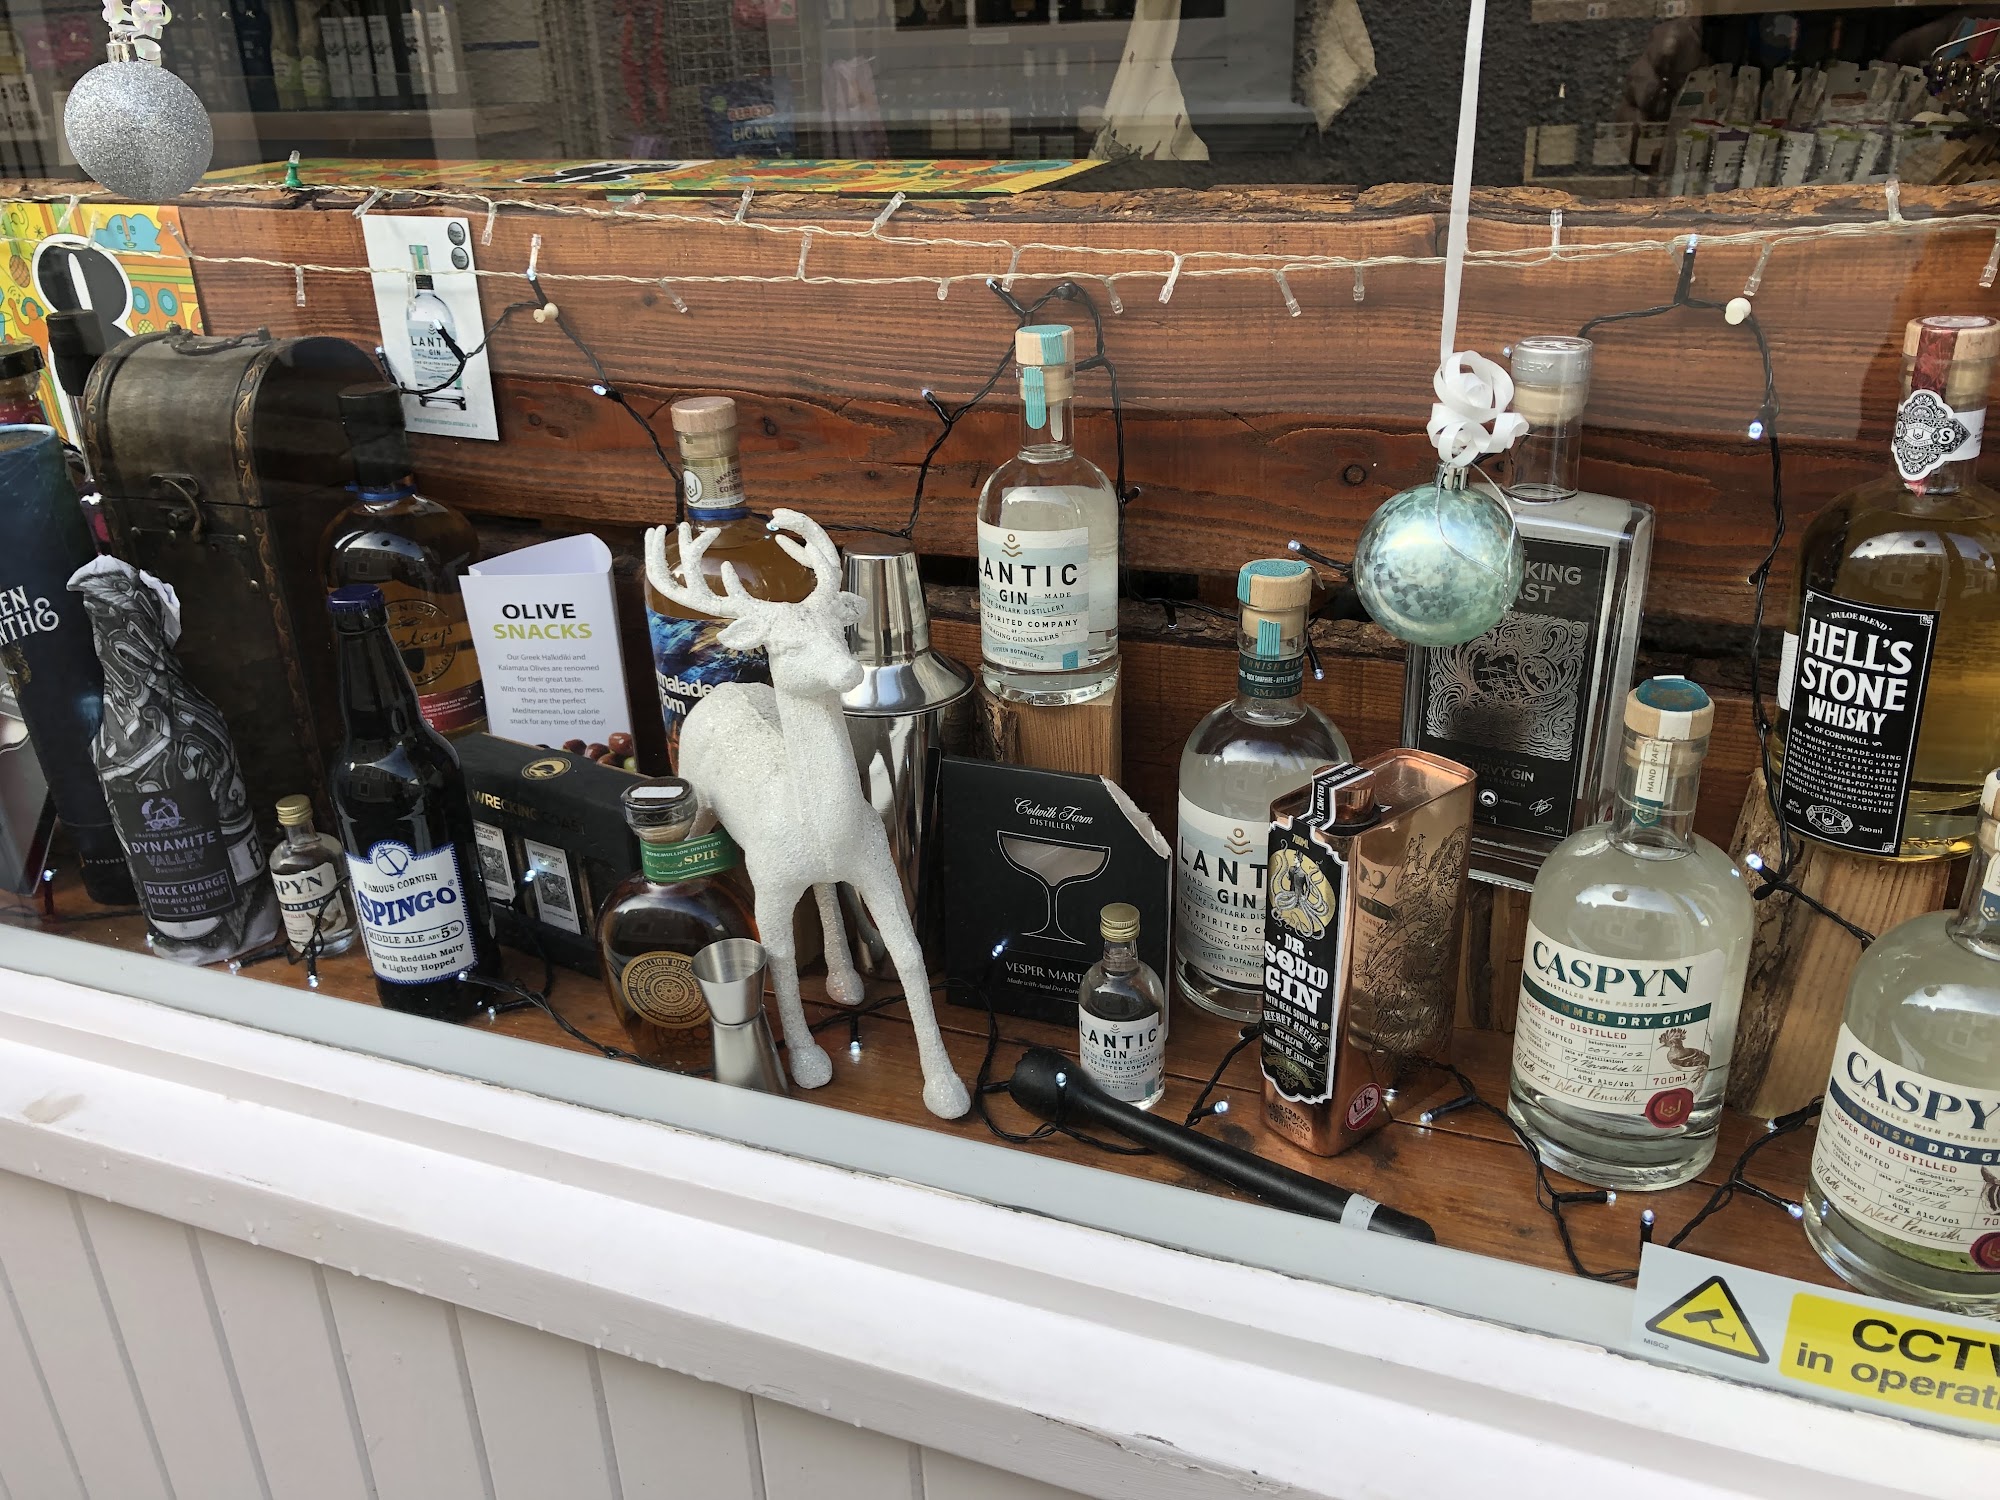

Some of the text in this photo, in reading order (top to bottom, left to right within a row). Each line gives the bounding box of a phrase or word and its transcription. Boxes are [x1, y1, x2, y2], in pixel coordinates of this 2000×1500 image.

[995, 601, 1065, 614] SKYLARK DISTILLERY
[999, 589, 1028, 605] GIN
[502, 603, 577, 619] OLIVE
[987, 610, 1078, 628] SPIRITED COMPANY
[1831, 611, 1888, 631] DULOE BLEND
[493, 623, 592, 639] SNACKS
[1012, 633, 1060, 643] GINMAKERS
[1010, 648, 1044, 660] BOTANICALS
[1806, 617, 1914, 675] HELL'S
[545, 676, 563, 684] great
[1801, 657, 1909, 712] STONE
[512, 707, 562, 715] Mediterranean,
[521, 697, 536, 705] they
[660, 687, 686, 715] Tom
[1808, 694, 1887, 735] WHISKY
[1806, 734, 1901, 761] WHISKY MADE USING
[1814, 726, 1869, 746] OF CORNWALL
[1790, 742, 1899, 776] INNOVATIVE CRAFT BEER
[1807, 742, 1826, 754] MOST
[1831, 751, 1873, 765] EXCITING
[1511, 769, 1535, 782] GIN
[1647, 769, 1656, 792] HAND
[1824, 773, 1897, 792] COPPER STILL
[1837, 769, 1873, 781] JACKSON
[1810, 791, 1893, 815] CORNISH COASTLINE
[1830, 790, 1857, 801] MOUNT
[1847, 786, 1881, 797] SHADOW
[473, 788, 537, 820] WRECKING
[1014, 798, 1094, 825] Colwith Farm
[1029, 817, 1076, 831] DISTILLERY
[131, 830, 217, 854] DYNAMITE
[690, 841, 721, 852] DISTILLERY
[146, 847, 205, 866] VALLEY
[146, 874, 227, 896] BLACK CHARGE
[363, 873, 438, 893] FAMOUS CORNISH
[1183, 869, 1203, 887] HAND
[358, 887, 457, 926] SPINGO
[1195, 892, 1246, 919] THE SKYLARK
[1217, 888, 1256, 910] GIN
[1195, 910, 1248, 933] SPIRITED
[368, 930, 401, 944] MIDDLE
[404, 934, 425, 944] ALE
[1190, 920, 1230, 947] FORAGING
[372, 943, 464, 963] Smooth Reddish Malty
[389, 957, 456, 973] Lightly Hopped
[629, 958, 669, 988] ROSEMULLION
[1005, 961, 1046, 977] VESPER
[1264, 940, 1329, 990] SQUID
[1532, 940, 1694, 998] CASPYN
[1265, 965, 1322, 1014] GIN
[1546, 980, 1658, 1008] DISTILLED WITH PASSION
[1265, 992, 1319, 1029] WITH REAL SQUID INK
[1526, 999, 1627, 1040] COPPER POT DISTILLED
[1618, 1012, 1693, 1026] DRY GIN
[1081, 1020, 1157, 1049] LANTIC
[1263, 1010, 1323, 1050] SECRET RECIPE
[1530, 1018, 1573, 1045] HAND CRAFTED
[1090, 1057, 1157, 1071] SPIRITED COMPANY
[1103, 1049, 1127, 1059] GIN
[1526, 1047, 1556, 1070] INDEPENDENT
[1515, 1047, 1584, 1093] Made West
[1653, 1074, 1688, 1086] 700ml
[1598, 1079, 1635, 1088] Alc/Vol
[1270, 1113, 1308, 1141] CORNWALL
[1285, 1105, 1311, 1133] CRAFTED
[1861, 1097, 1942, 1136] DISTILLED WITH
[1831, 1140, 1852, 1164] PRODUCE
[1834, 1108, 1957, 1174] COPPER POT DISTILLED
[1836, 1129, 1890, 1170] HAND CRAFTED
[1927, 1143, 1974, 1160] DRY
[1832, 1149, 1857, 1172] CORNWALL
[1830, 1161, 1866, 1193] INDEPENDENT
[1816, 1157, 1841, 1193] Made
[1862, 1205, 1897, 1224] West
[1892, 1202, 1961, 1225] 40% Alc/Vol
[1643, 1338, 1670, 1351] MISC2
[1852, 1318, 2000, 1378] CCT
[1795, 1342, 2000, 1411] in operat
